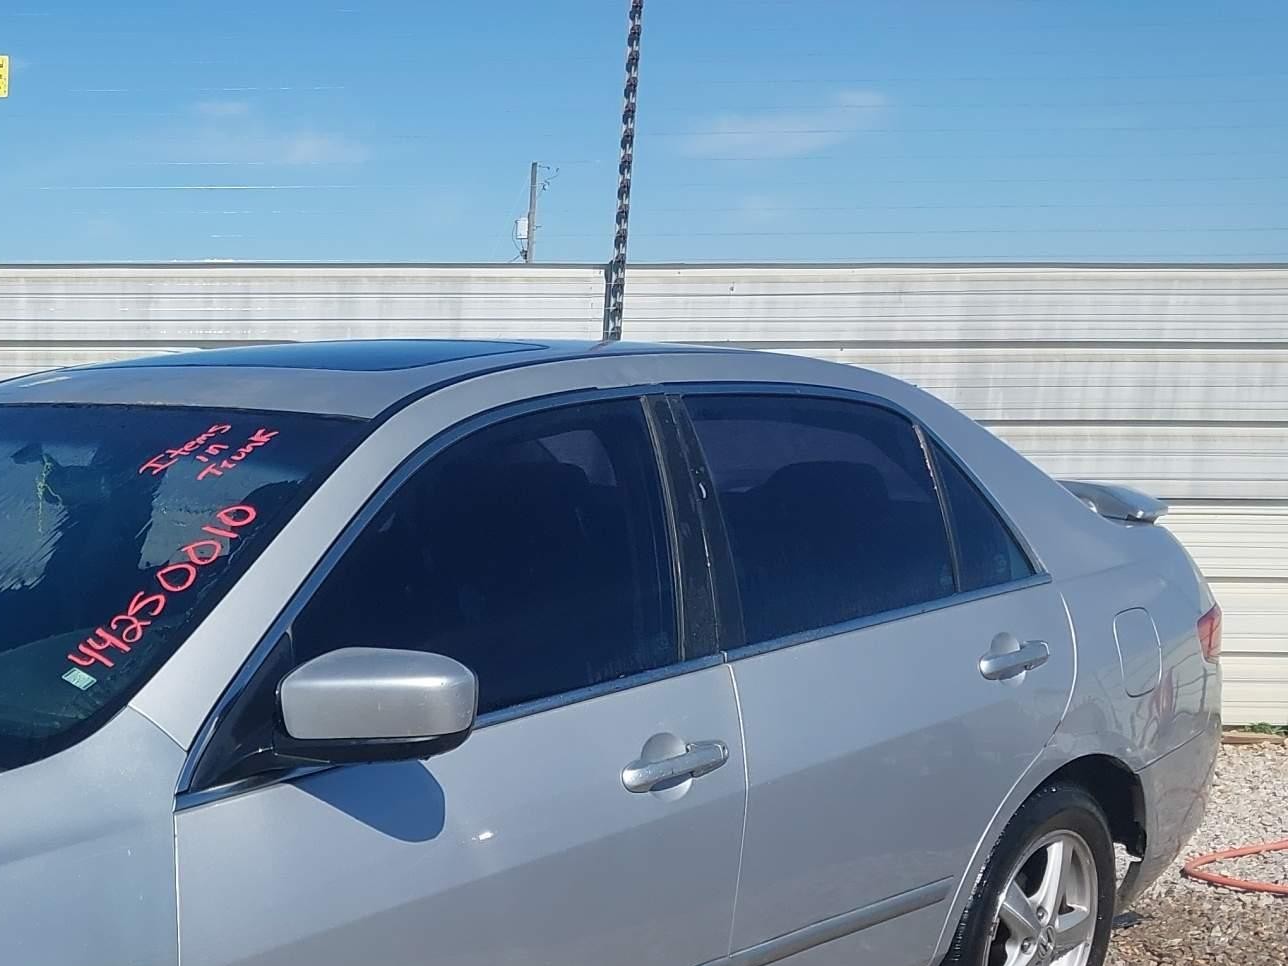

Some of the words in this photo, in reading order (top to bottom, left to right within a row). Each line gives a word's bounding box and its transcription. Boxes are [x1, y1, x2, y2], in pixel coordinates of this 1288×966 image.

[139, 423, 231, 475] Items
[196, 444, 229, 462] in
[67, 504, 257, 668] 44250010
